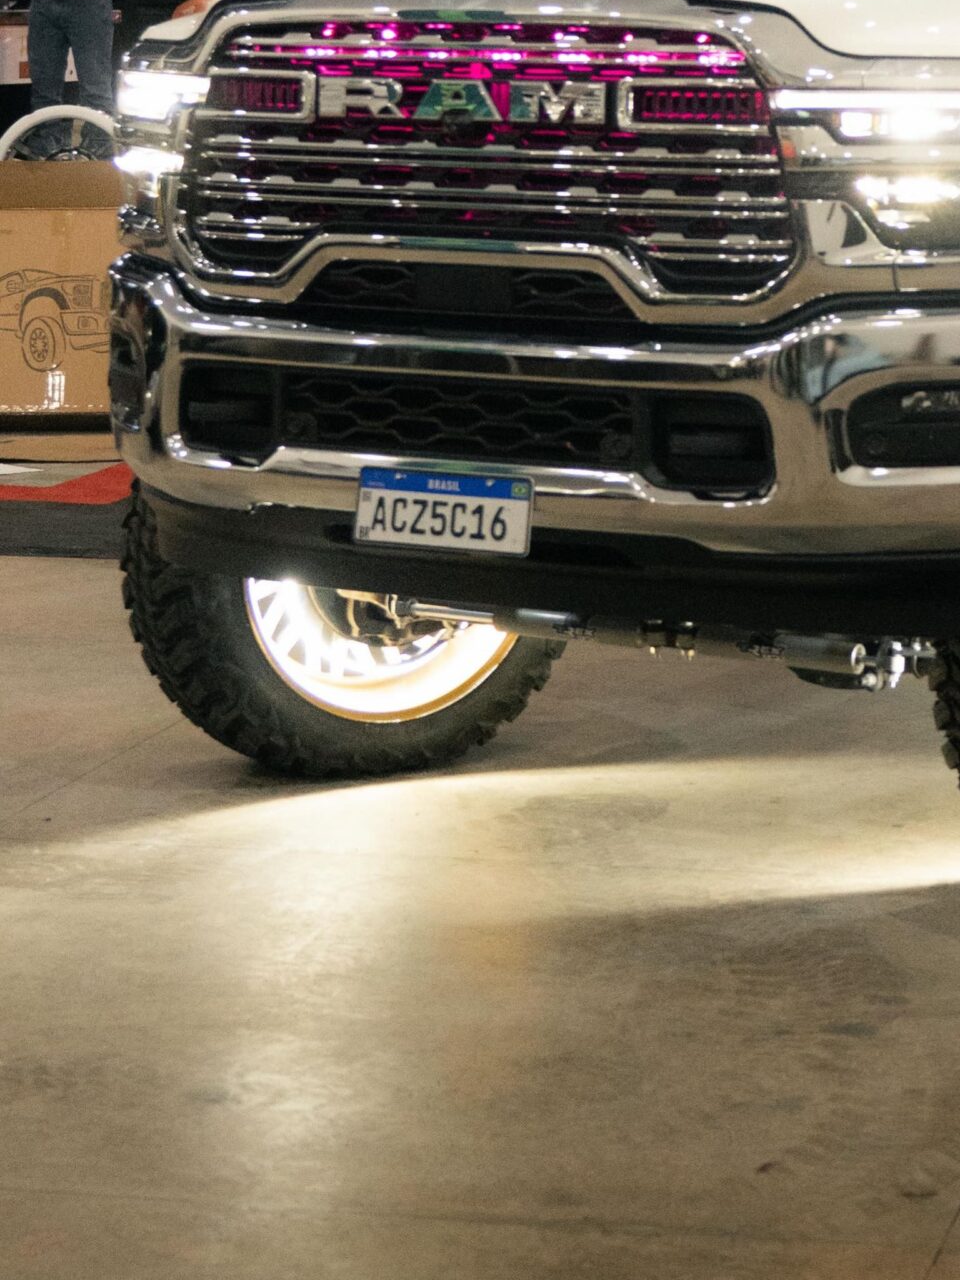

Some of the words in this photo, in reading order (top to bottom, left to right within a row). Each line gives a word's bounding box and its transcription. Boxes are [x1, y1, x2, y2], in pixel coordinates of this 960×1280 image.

[316, 76, 606, 124] RAM
[427, 478, 460, 491] BRASIL
[371, 496, 507, 541] ACZ5C16
